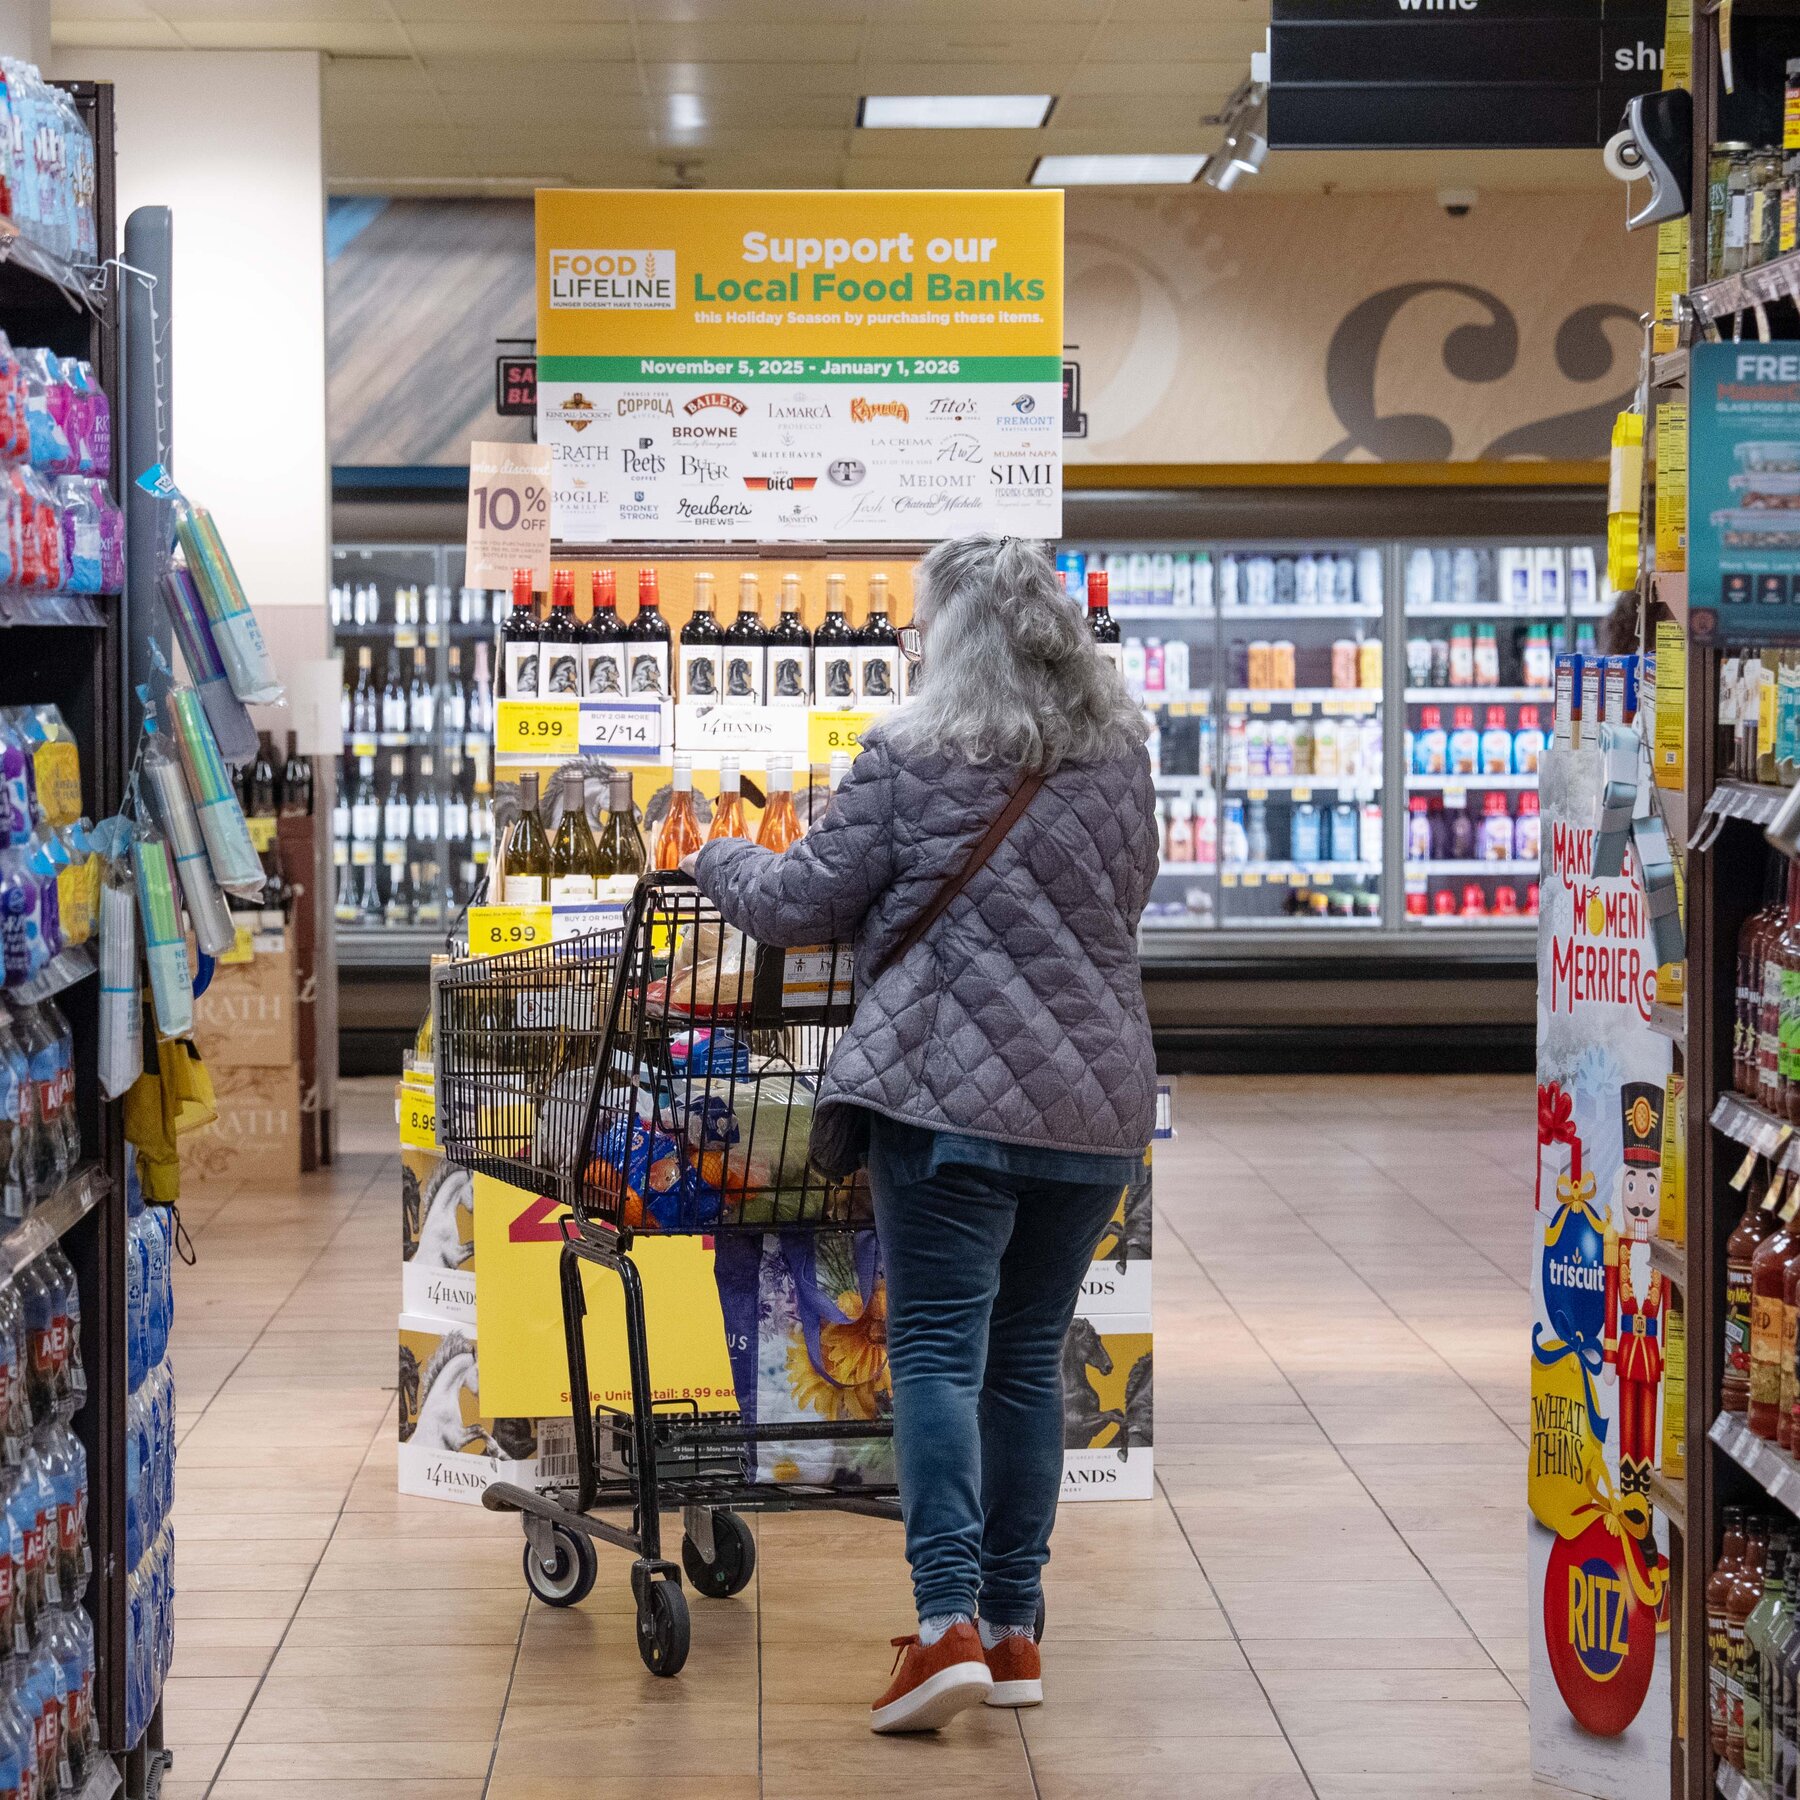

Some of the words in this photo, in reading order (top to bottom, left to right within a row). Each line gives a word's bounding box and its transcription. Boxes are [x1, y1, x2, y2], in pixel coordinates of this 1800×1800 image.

[742, 230, 913, 269] Support
[925, 237, 997, 263] our
[553, 255, 637, 276] FOOD
[553, 279, 670, 298] LIFELINE
[694, 272, 797, 303] Local
[813, 272, 913, 303] Food
[927, 272, 1045, 303] Banks
[694, 310, 722, 324] this
[726, 310, 783, 328] Holiday
[787, 311, 840, 324] Season
[844, 310, 864, 328] by
[867, 310, 950, 328] purchasing
[954, 311, 995, 324] these
[998, 311, 1045, 324] items.
[641, 359, 733, 375] November
[738, 359, 755, 378] 5,
[759, 359, 804, 375] 2025
[820, 359, 888, 379] January
[892, 359, 910, 378] 1,
[914, 359, 960, 375] 2026
[617, 398, 675, 418] COPPOLA
[686, 393, 744, 413] BAILEYS
[929, 397, 977, 413] Tito's
[996, 416, 1054, 425] FREMONT
[672, 426, 738, 438] BROWNE
[551, 443, 609, 462] ERATH
[621, 449, 666, 474] Peet's
[993, 450, 1026, 458] MUMM
[900, 474, 971, 487] MEIOMI
[990, 464, 1052, 485] SIMI
[619, 504, 659, 512] RODNEY
[521, 518, 546, 531] OFF
[518, 721, 563, 736] 8.99
[703, 718, 721, 736] 14
[723, 723, 772, 734] HANDS
[829, 732, 858, 746] 8.9
[490, 926, 536, 943] 8.99
[1552, 935, 1656, 1021] MERRIER
[1550, 1257, 1605, 1292] triscuit
[428, 1281, 442, 1304] 14
[1080, 1281, 1115, 1295] NDS
[560, 1391, 601, 1402] Sile
[605, 1390, 633, 1401] Unit
[650, 1388, 678, 1400] etail:
[682, 1388, 711, 1399] 8.99
[715, 1388, 737, 1398] eac
[1532, 1393, 1586, 1437] WHEAT
[426, 1463, 442, 1486] 14
[443, 1470, 487, 1488] HANDS
[1063, 1469, 1117, 1483] ANDS
[1568, 1564, 1629, 1656] RITZ
